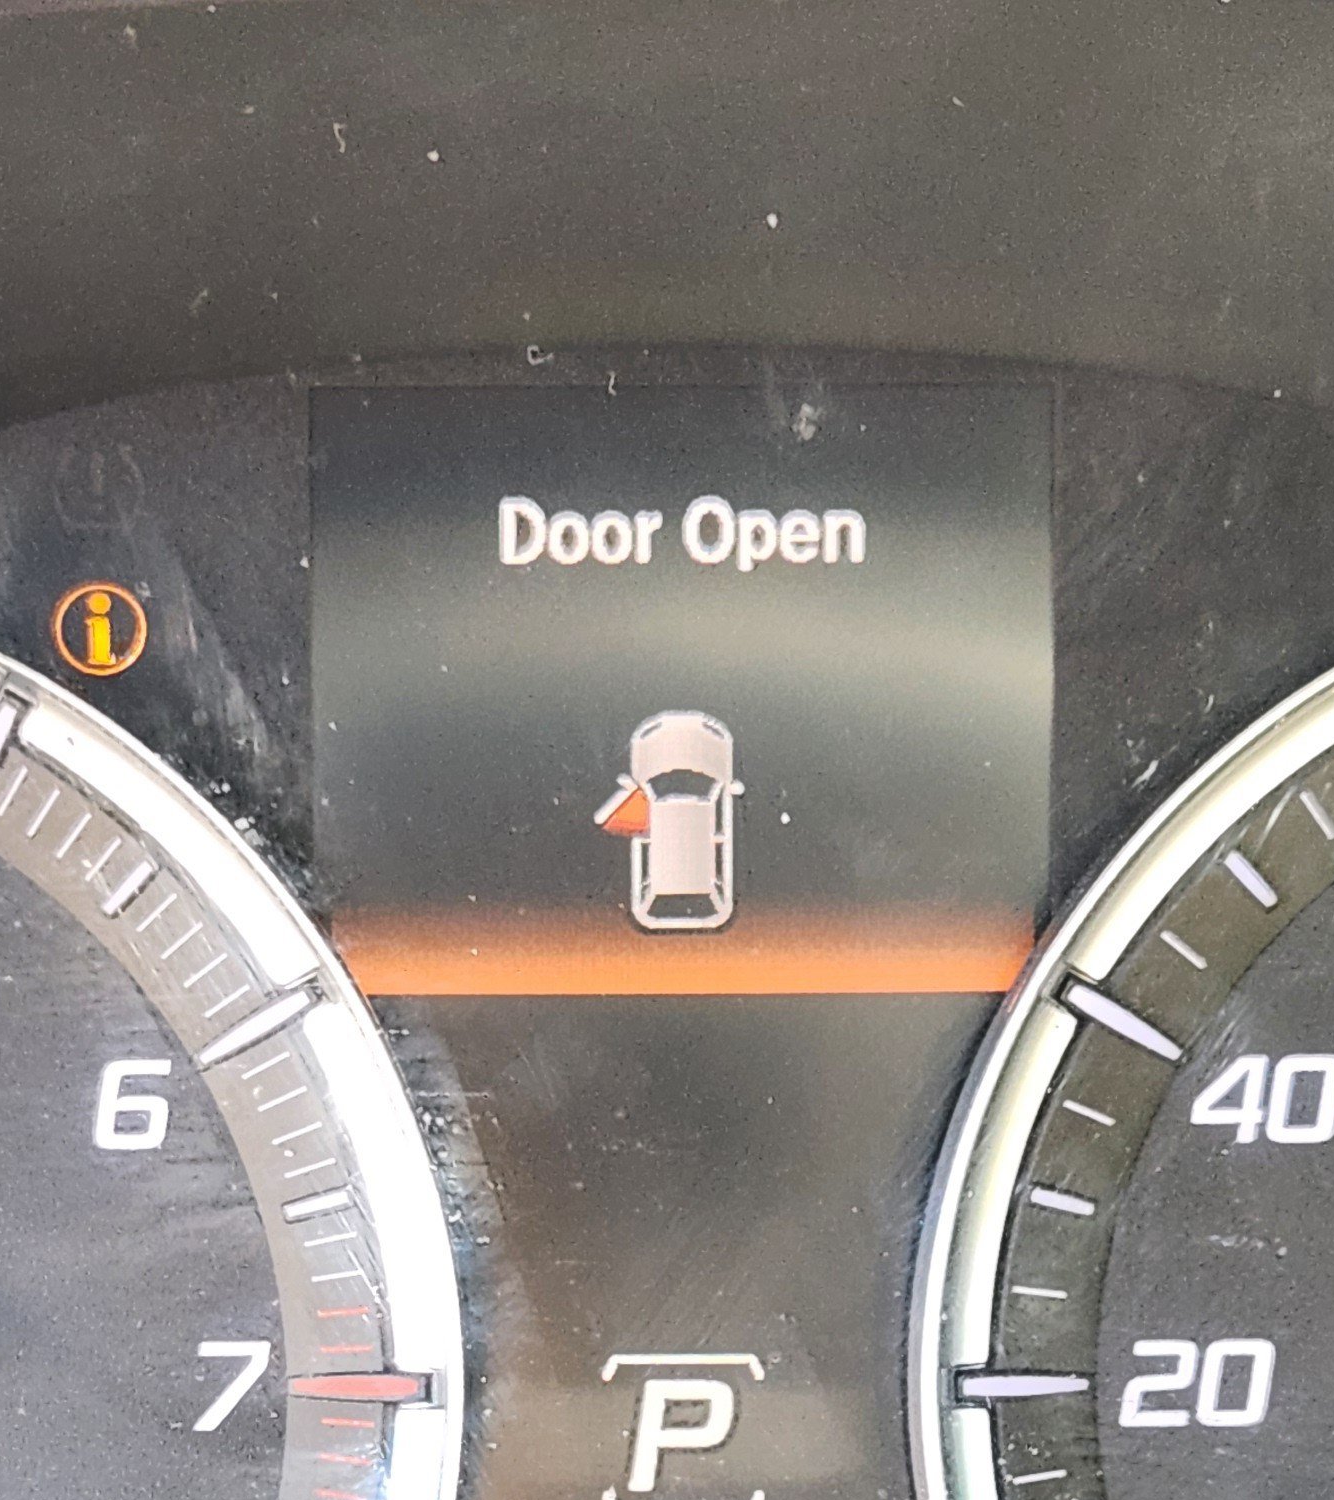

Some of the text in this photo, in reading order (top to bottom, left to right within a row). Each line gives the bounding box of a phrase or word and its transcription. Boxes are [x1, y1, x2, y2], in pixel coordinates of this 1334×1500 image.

[499, 496, 866, 572] Door Open
[93, 1059, 171, 1150] 6
[193, 1341, 271, 1431] 7
[1119, 1339, 1275, 1427] 20
[628, 1379, 733, 1491] P
